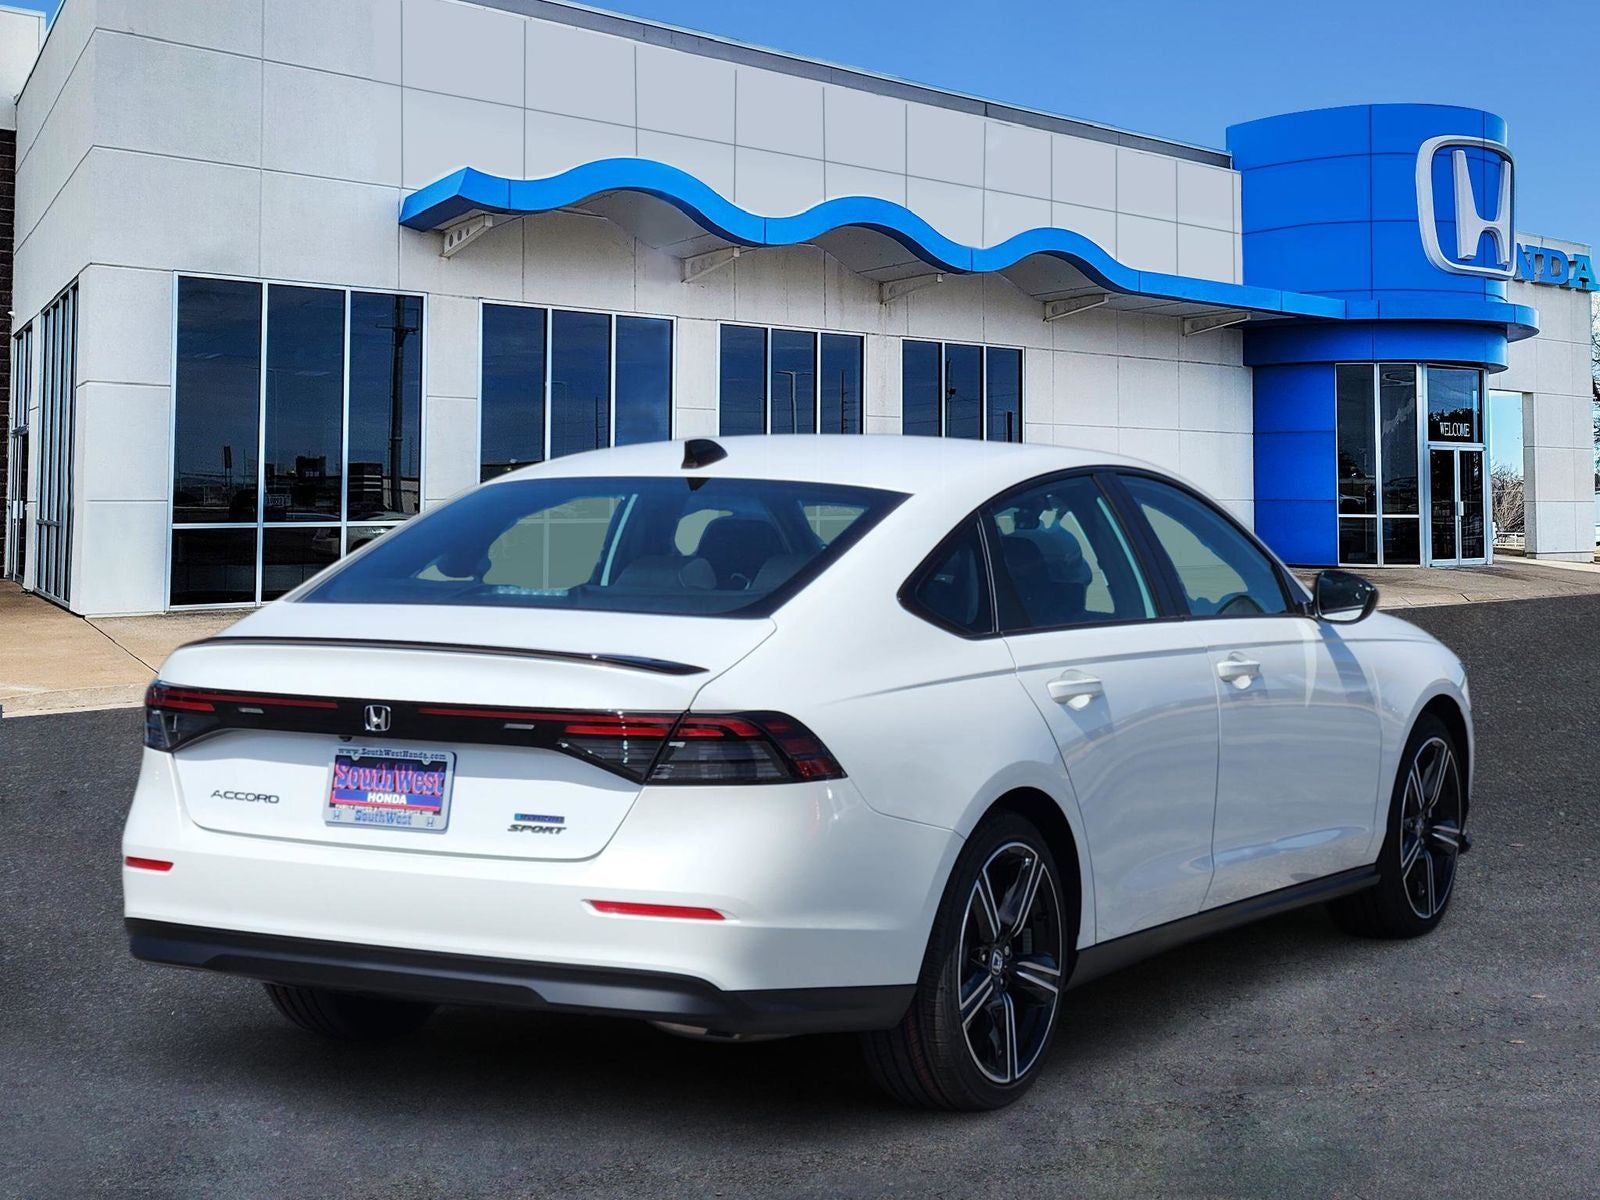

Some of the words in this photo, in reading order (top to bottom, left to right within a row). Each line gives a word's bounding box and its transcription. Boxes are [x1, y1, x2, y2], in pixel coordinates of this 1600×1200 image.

[1512, 242, 1600, 292] NDA
[1439, 421, 1470, 437] WELCOME
[211, 790, 280, 804] ACCORD
[367, 792, 408, 804] HONDA
[354, 809, 412, 825] SouthWest
[507, 824, 567, 835] SPORT
